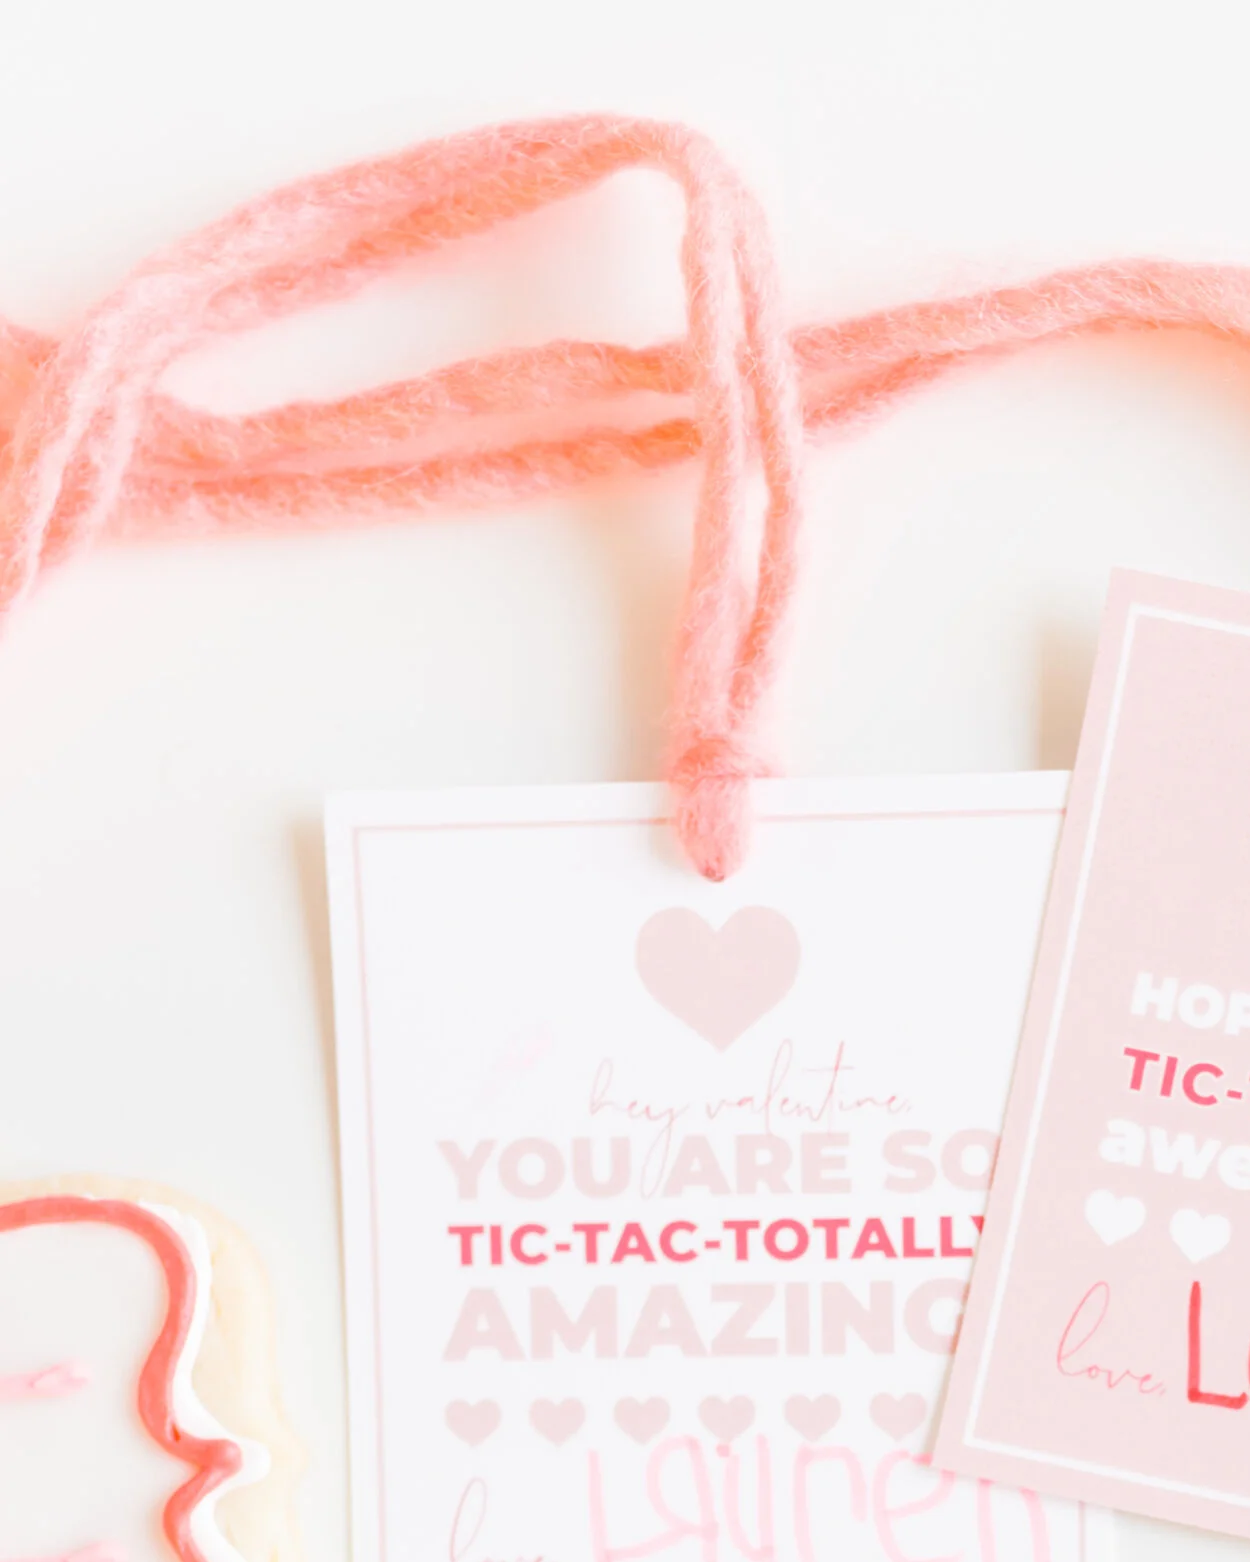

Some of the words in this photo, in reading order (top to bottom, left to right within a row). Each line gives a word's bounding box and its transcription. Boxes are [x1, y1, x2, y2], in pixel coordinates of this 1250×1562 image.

[435, 1136, 633, 1200] YOU
[661, 1130, 852, 1197] ARE
[881, 1127, 1001, 1195] SO
[588, 1056, 688, 1199] hey
[446, 1214, 986, 1268] TIC-TAC-TOTALL
